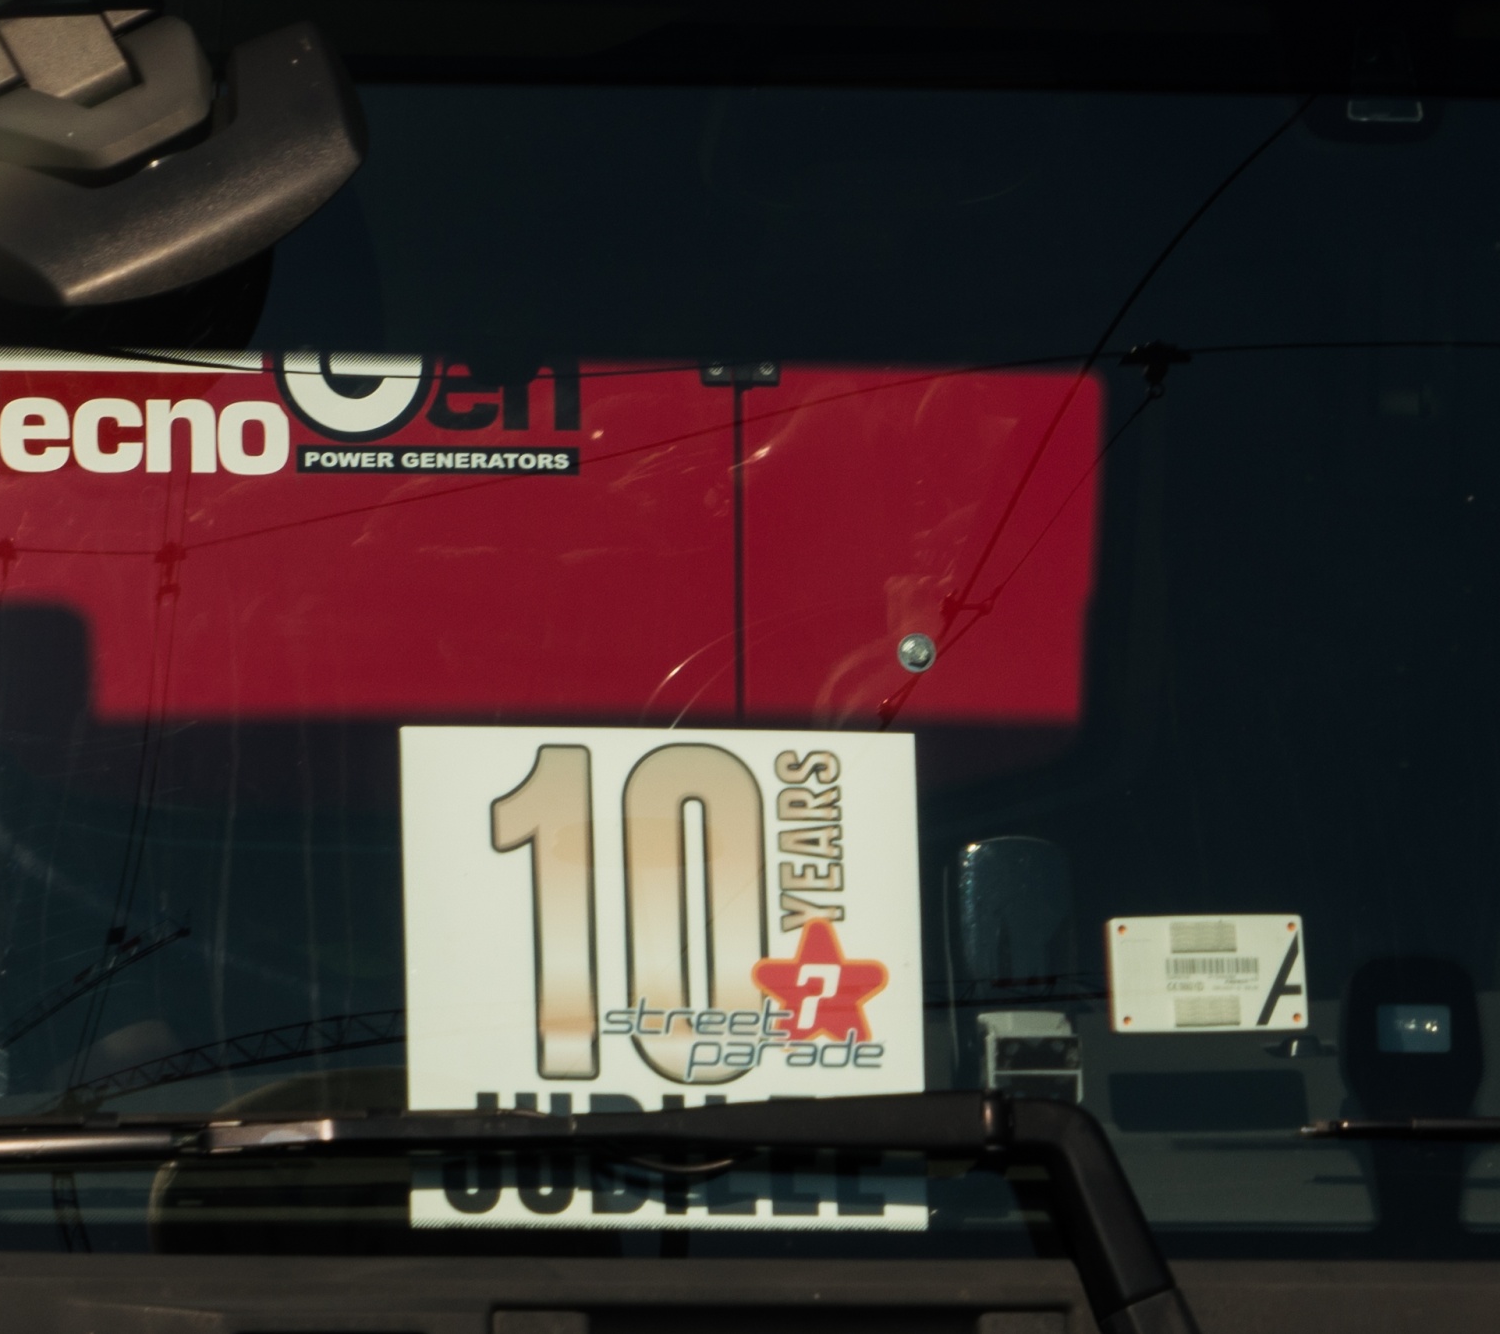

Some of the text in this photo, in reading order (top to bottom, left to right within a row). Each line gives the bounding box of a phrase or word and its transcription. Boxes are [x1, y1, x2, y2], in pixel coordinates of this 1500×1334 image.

[304, 450, 570, 471] POWER GENERATORS
[774, 749, 846, 934] YEARS
[490, 742, 770, 1086] 10
[602, 997, 794, 1040] street
[684, 1029, 885, 1084] parade
